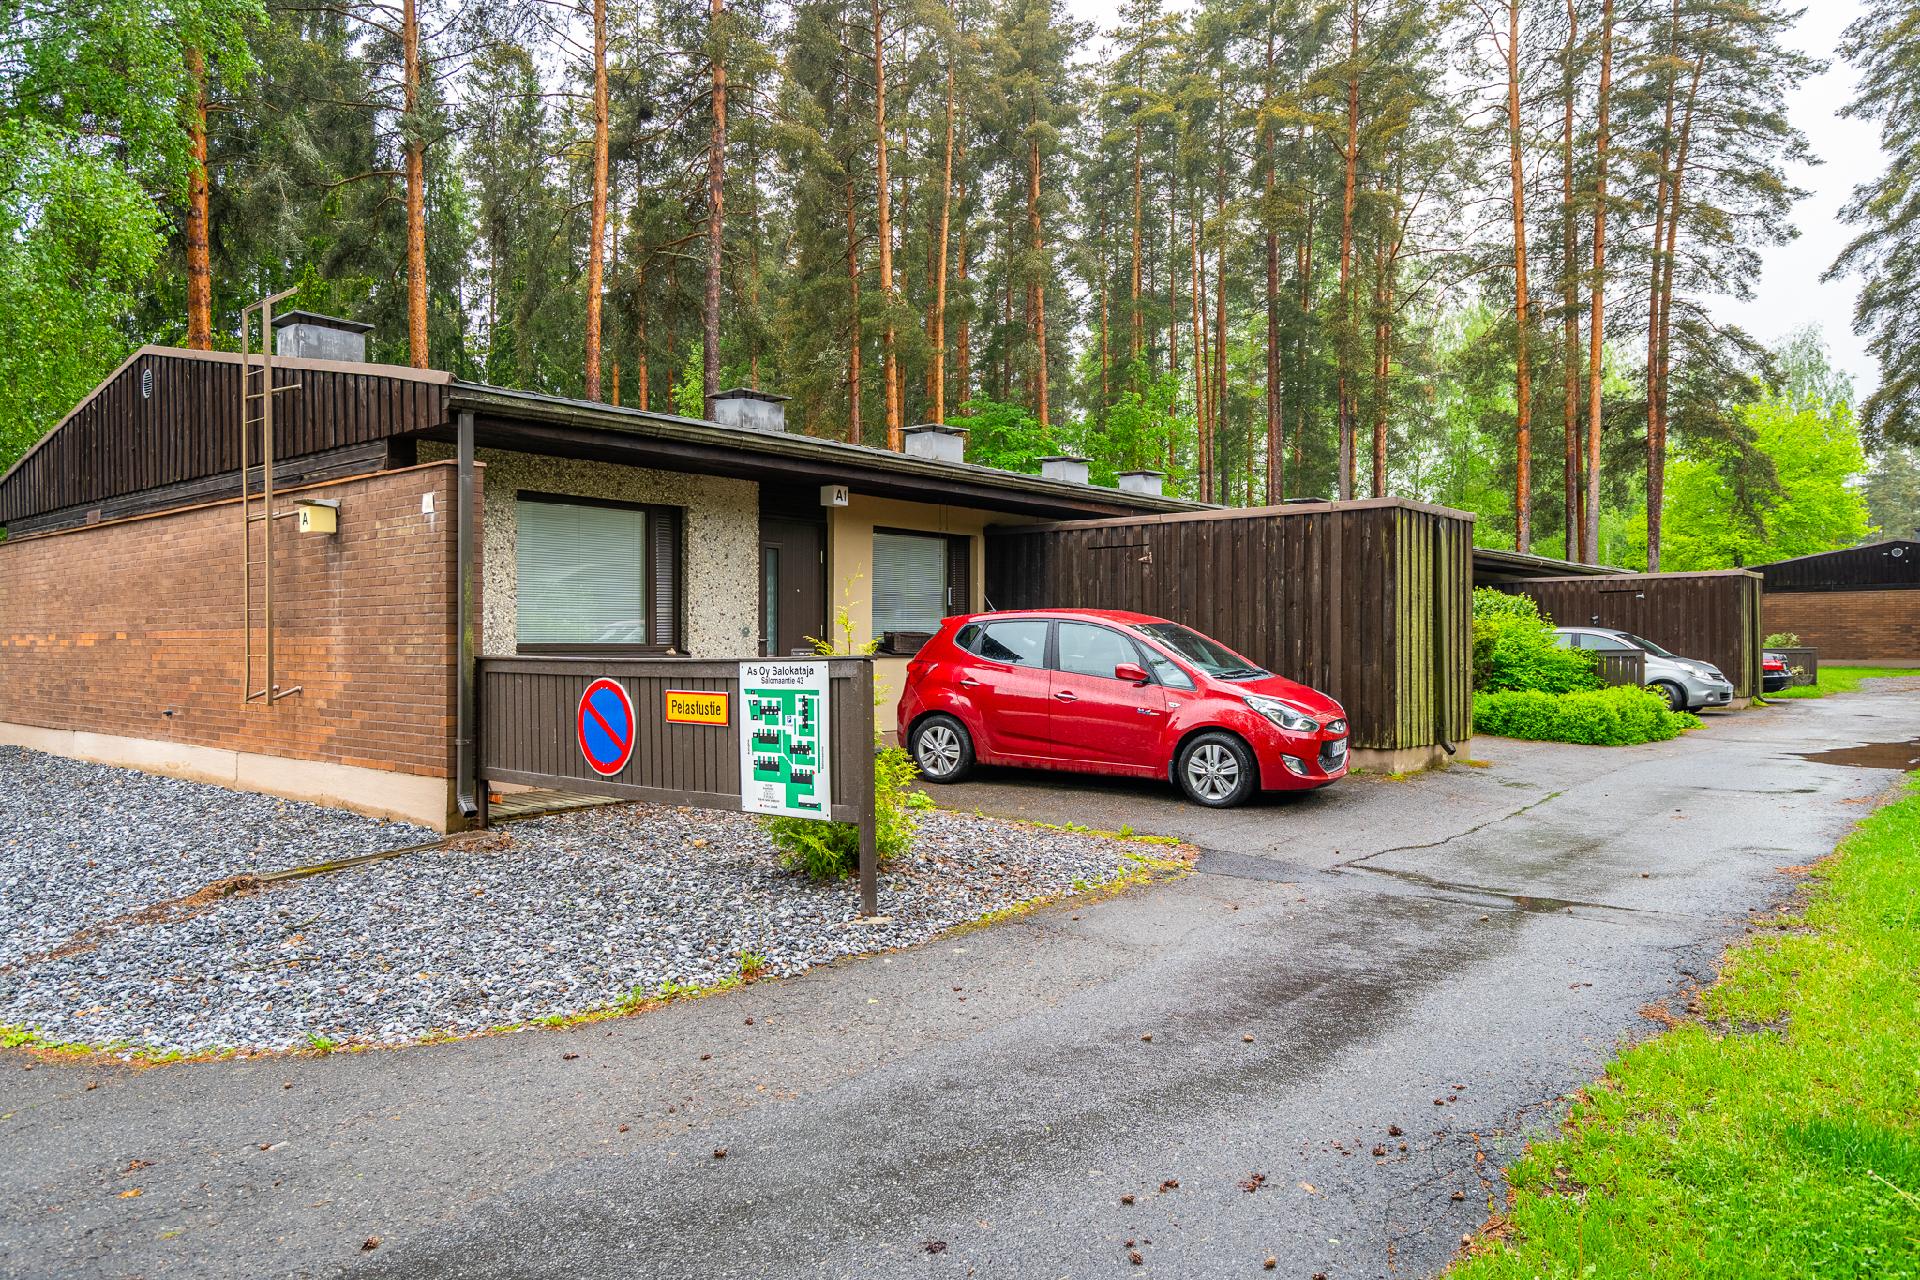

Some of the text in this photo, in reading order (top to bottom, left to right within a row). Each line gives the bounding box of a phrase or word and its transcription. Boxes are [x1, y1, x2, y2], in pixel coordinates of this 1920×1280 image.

[835, 489, 847, 502] A1
[302, 512, 309, 526] A
[747, 665, 814, 678] As Oy Salokataja
[671, 699, 721, 716] Pelastustie
